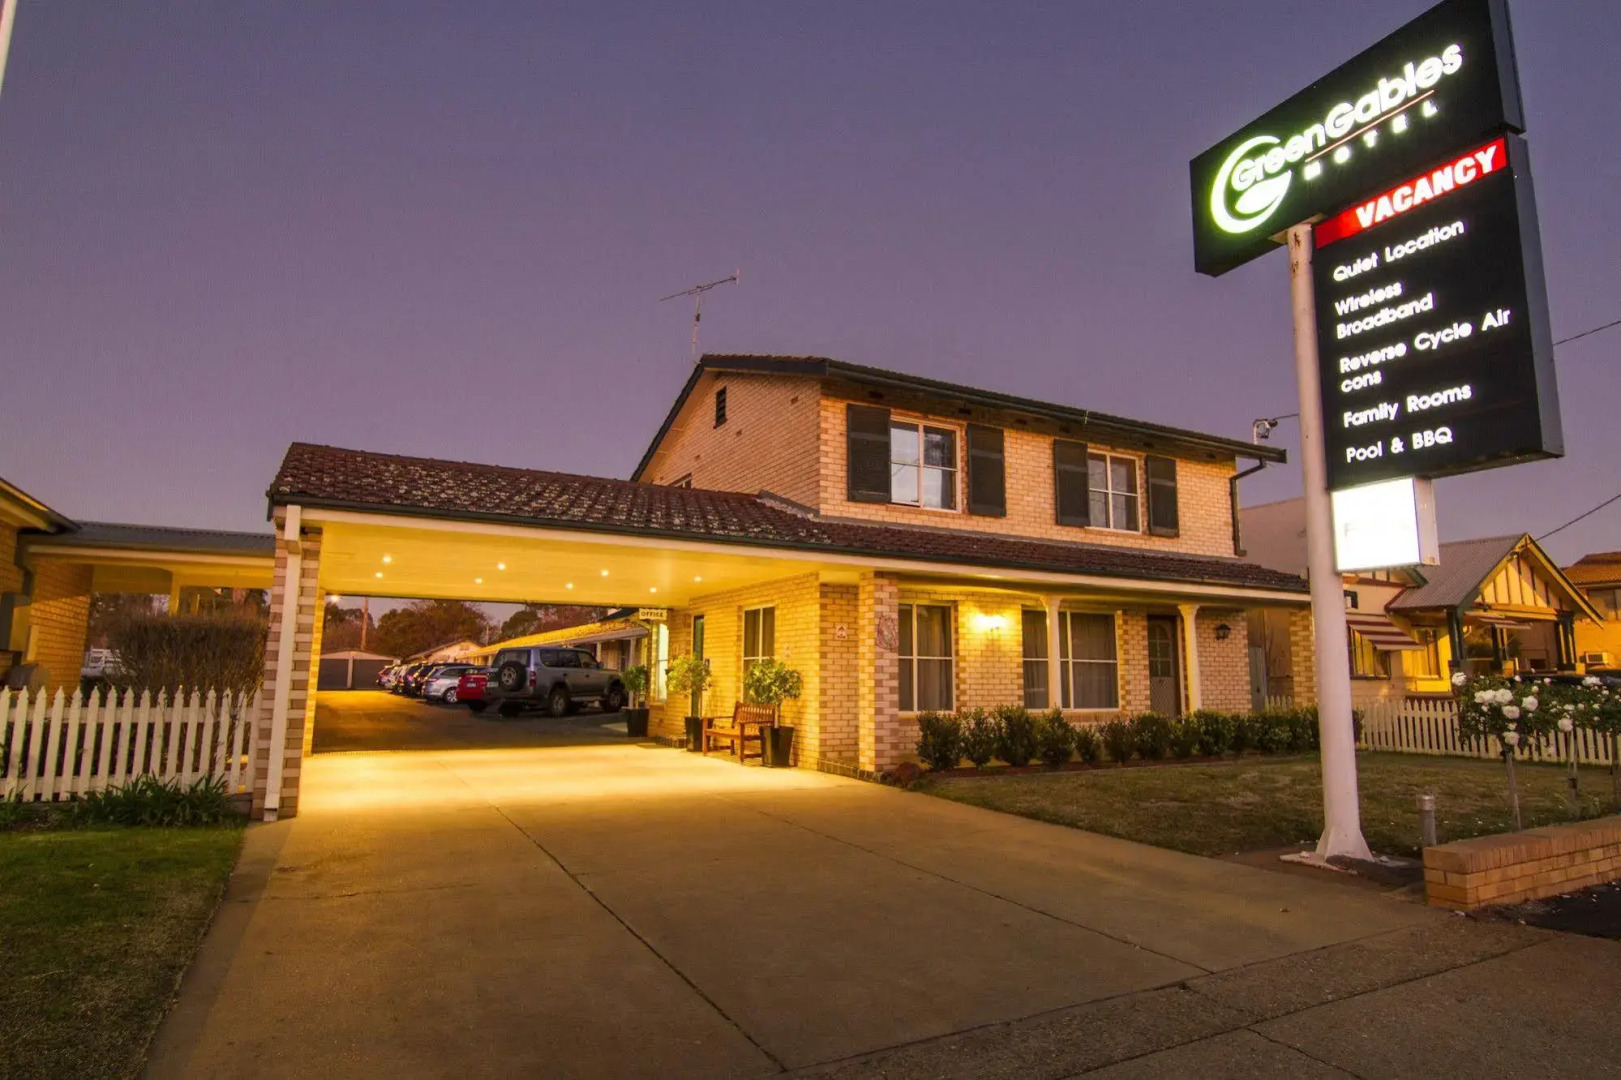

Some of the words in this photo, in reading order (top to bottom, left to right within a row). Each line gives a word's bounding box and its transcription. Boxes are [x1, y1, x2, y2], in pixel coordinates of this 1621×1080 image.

[1304, 100, 1438, 180] MOTEL
[1356, 145, 1497, 228] VACANCY
[1333, 253, 1379, 281] Quiet
[1385, 221, 1465, 262] Location
[1335, 282, 1403, 316] Wireless
[1337, 293, 1434, 339] Broadband
[1340, 343, 1407, 373] Reverse
[1414, 322, 1472, 350] Cycle
[1482, 309, 1511, 331] Air
[1341, 371, 1382, 393] cons
[1344, 402, 1399, 428] Family
[1407, 385, 1472, 413] Rooms
[1346, 441, 1383, 463] Pool
[1391, 437, 1404, 454] &
[1412, 427, 1453, 450] BBQ
